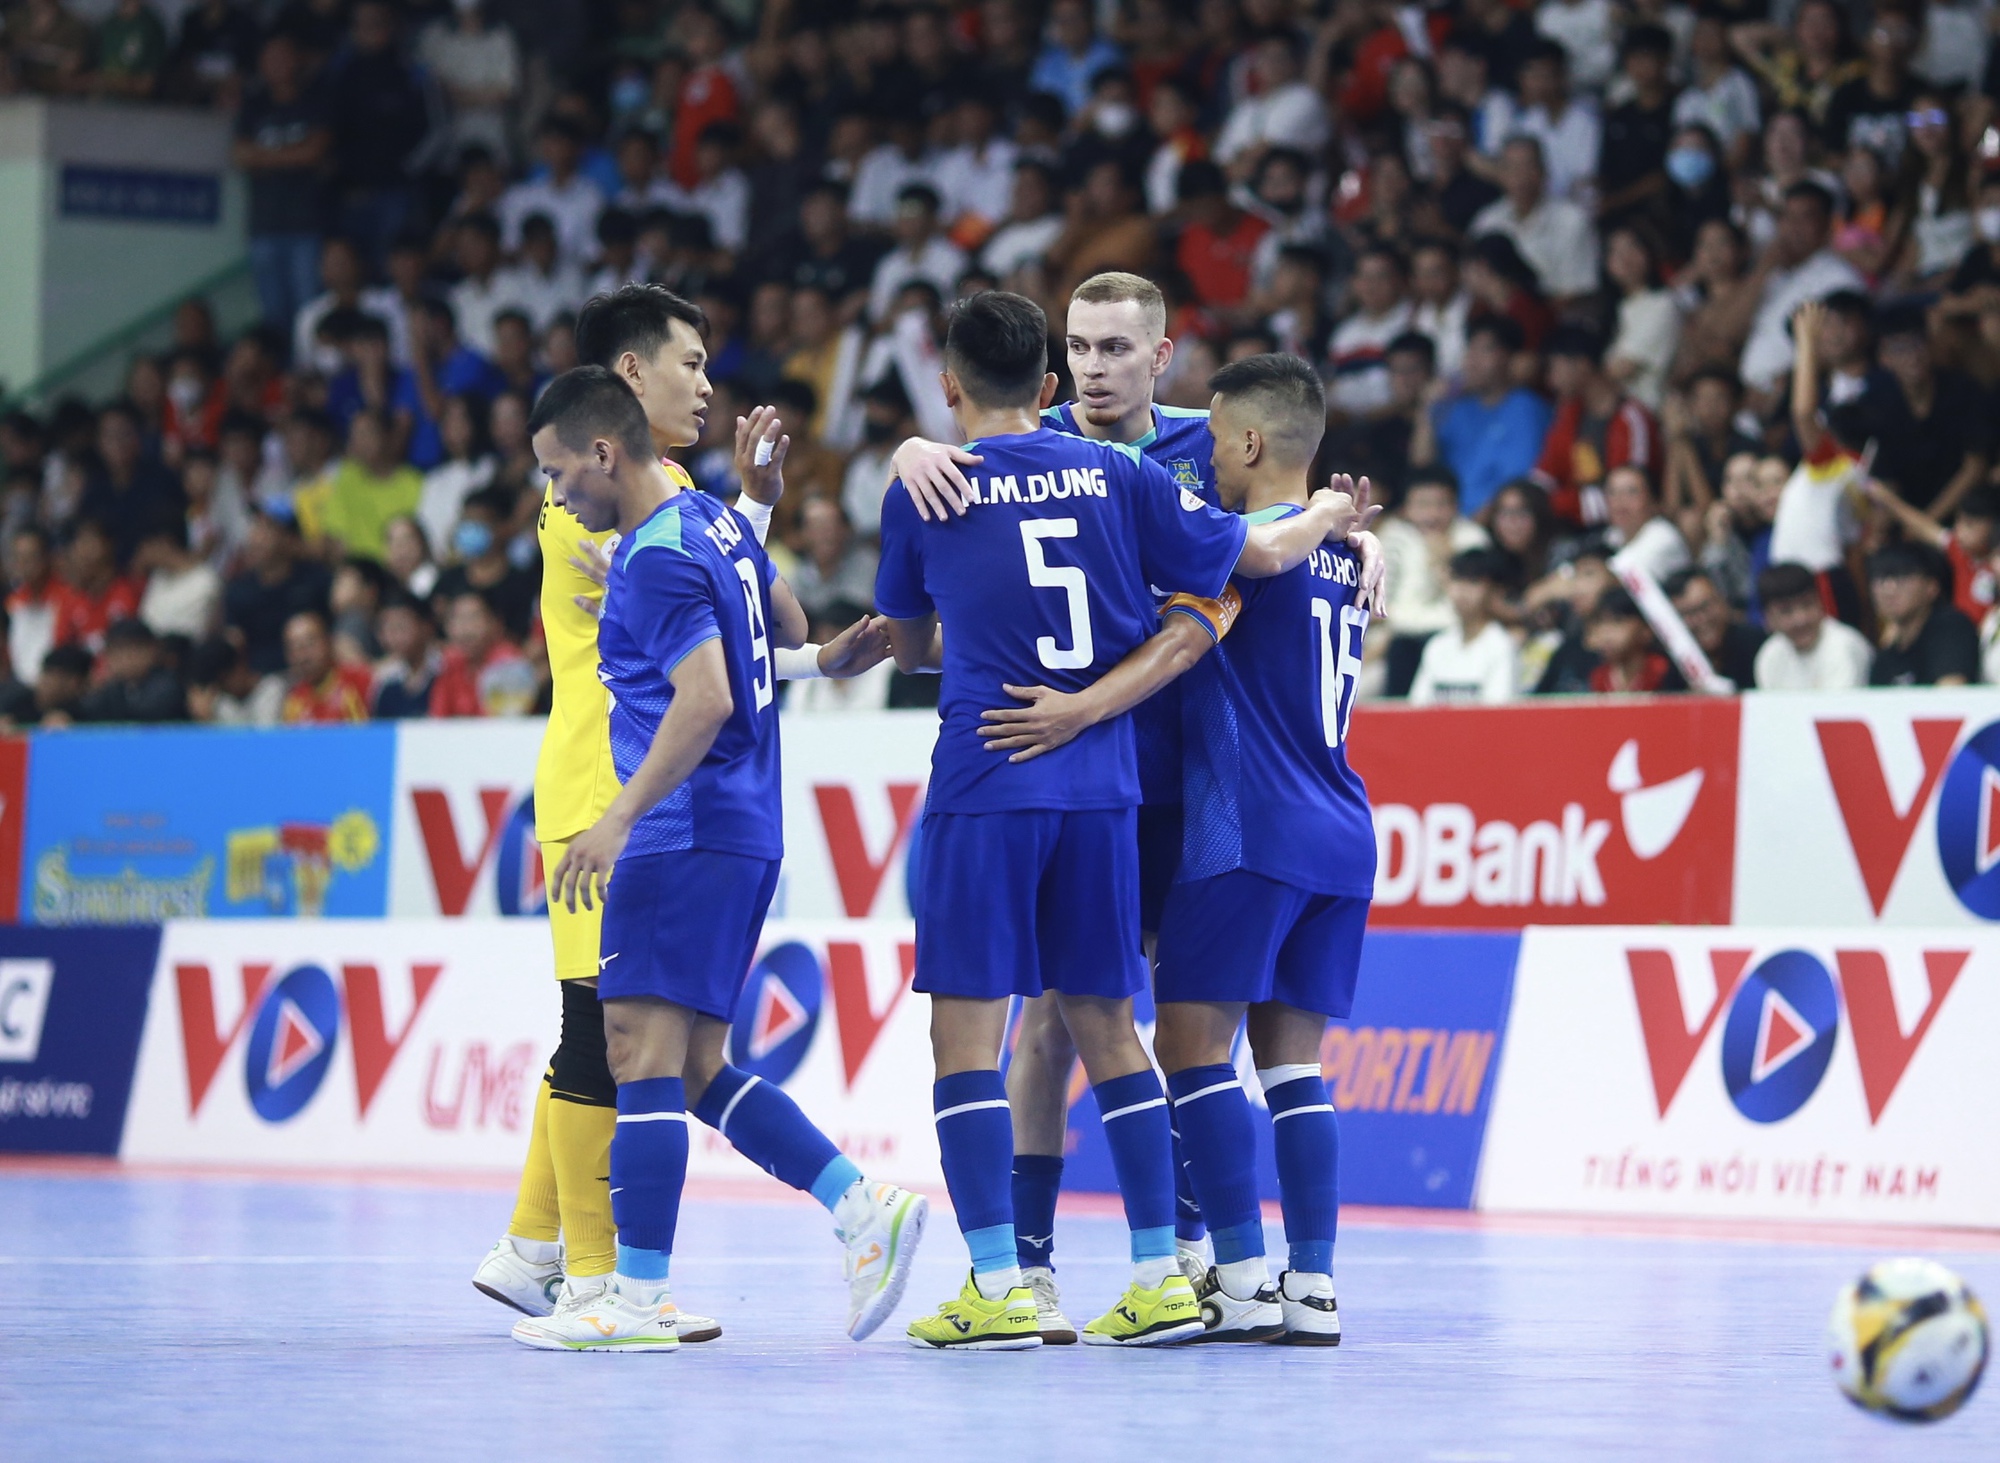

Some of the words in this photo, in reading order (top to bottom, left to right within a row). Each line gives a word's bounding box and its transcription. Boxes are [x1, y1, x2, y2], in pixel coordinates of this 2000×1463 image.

[960, 467, 1108, 507] N.M.DUNG
[1172, 462, 1191, 471] TSN
[539, 501, 549, 530] G
[1018, 517, 1094, 670] 5
[1308, 549, 1362, 588] P.D.HO
[733, 556, 774, 714] 9
[1373, 802, 1612, 905] DBank
[1, 977, 31, 1040] C
[172, 963, 444, 1123] VOV
[1623, 947, 1972, 1128] VOV
[1320, 1025, 1495, 1115] PORT.VN
[1861, 1163, 1939, 1199] NAM
